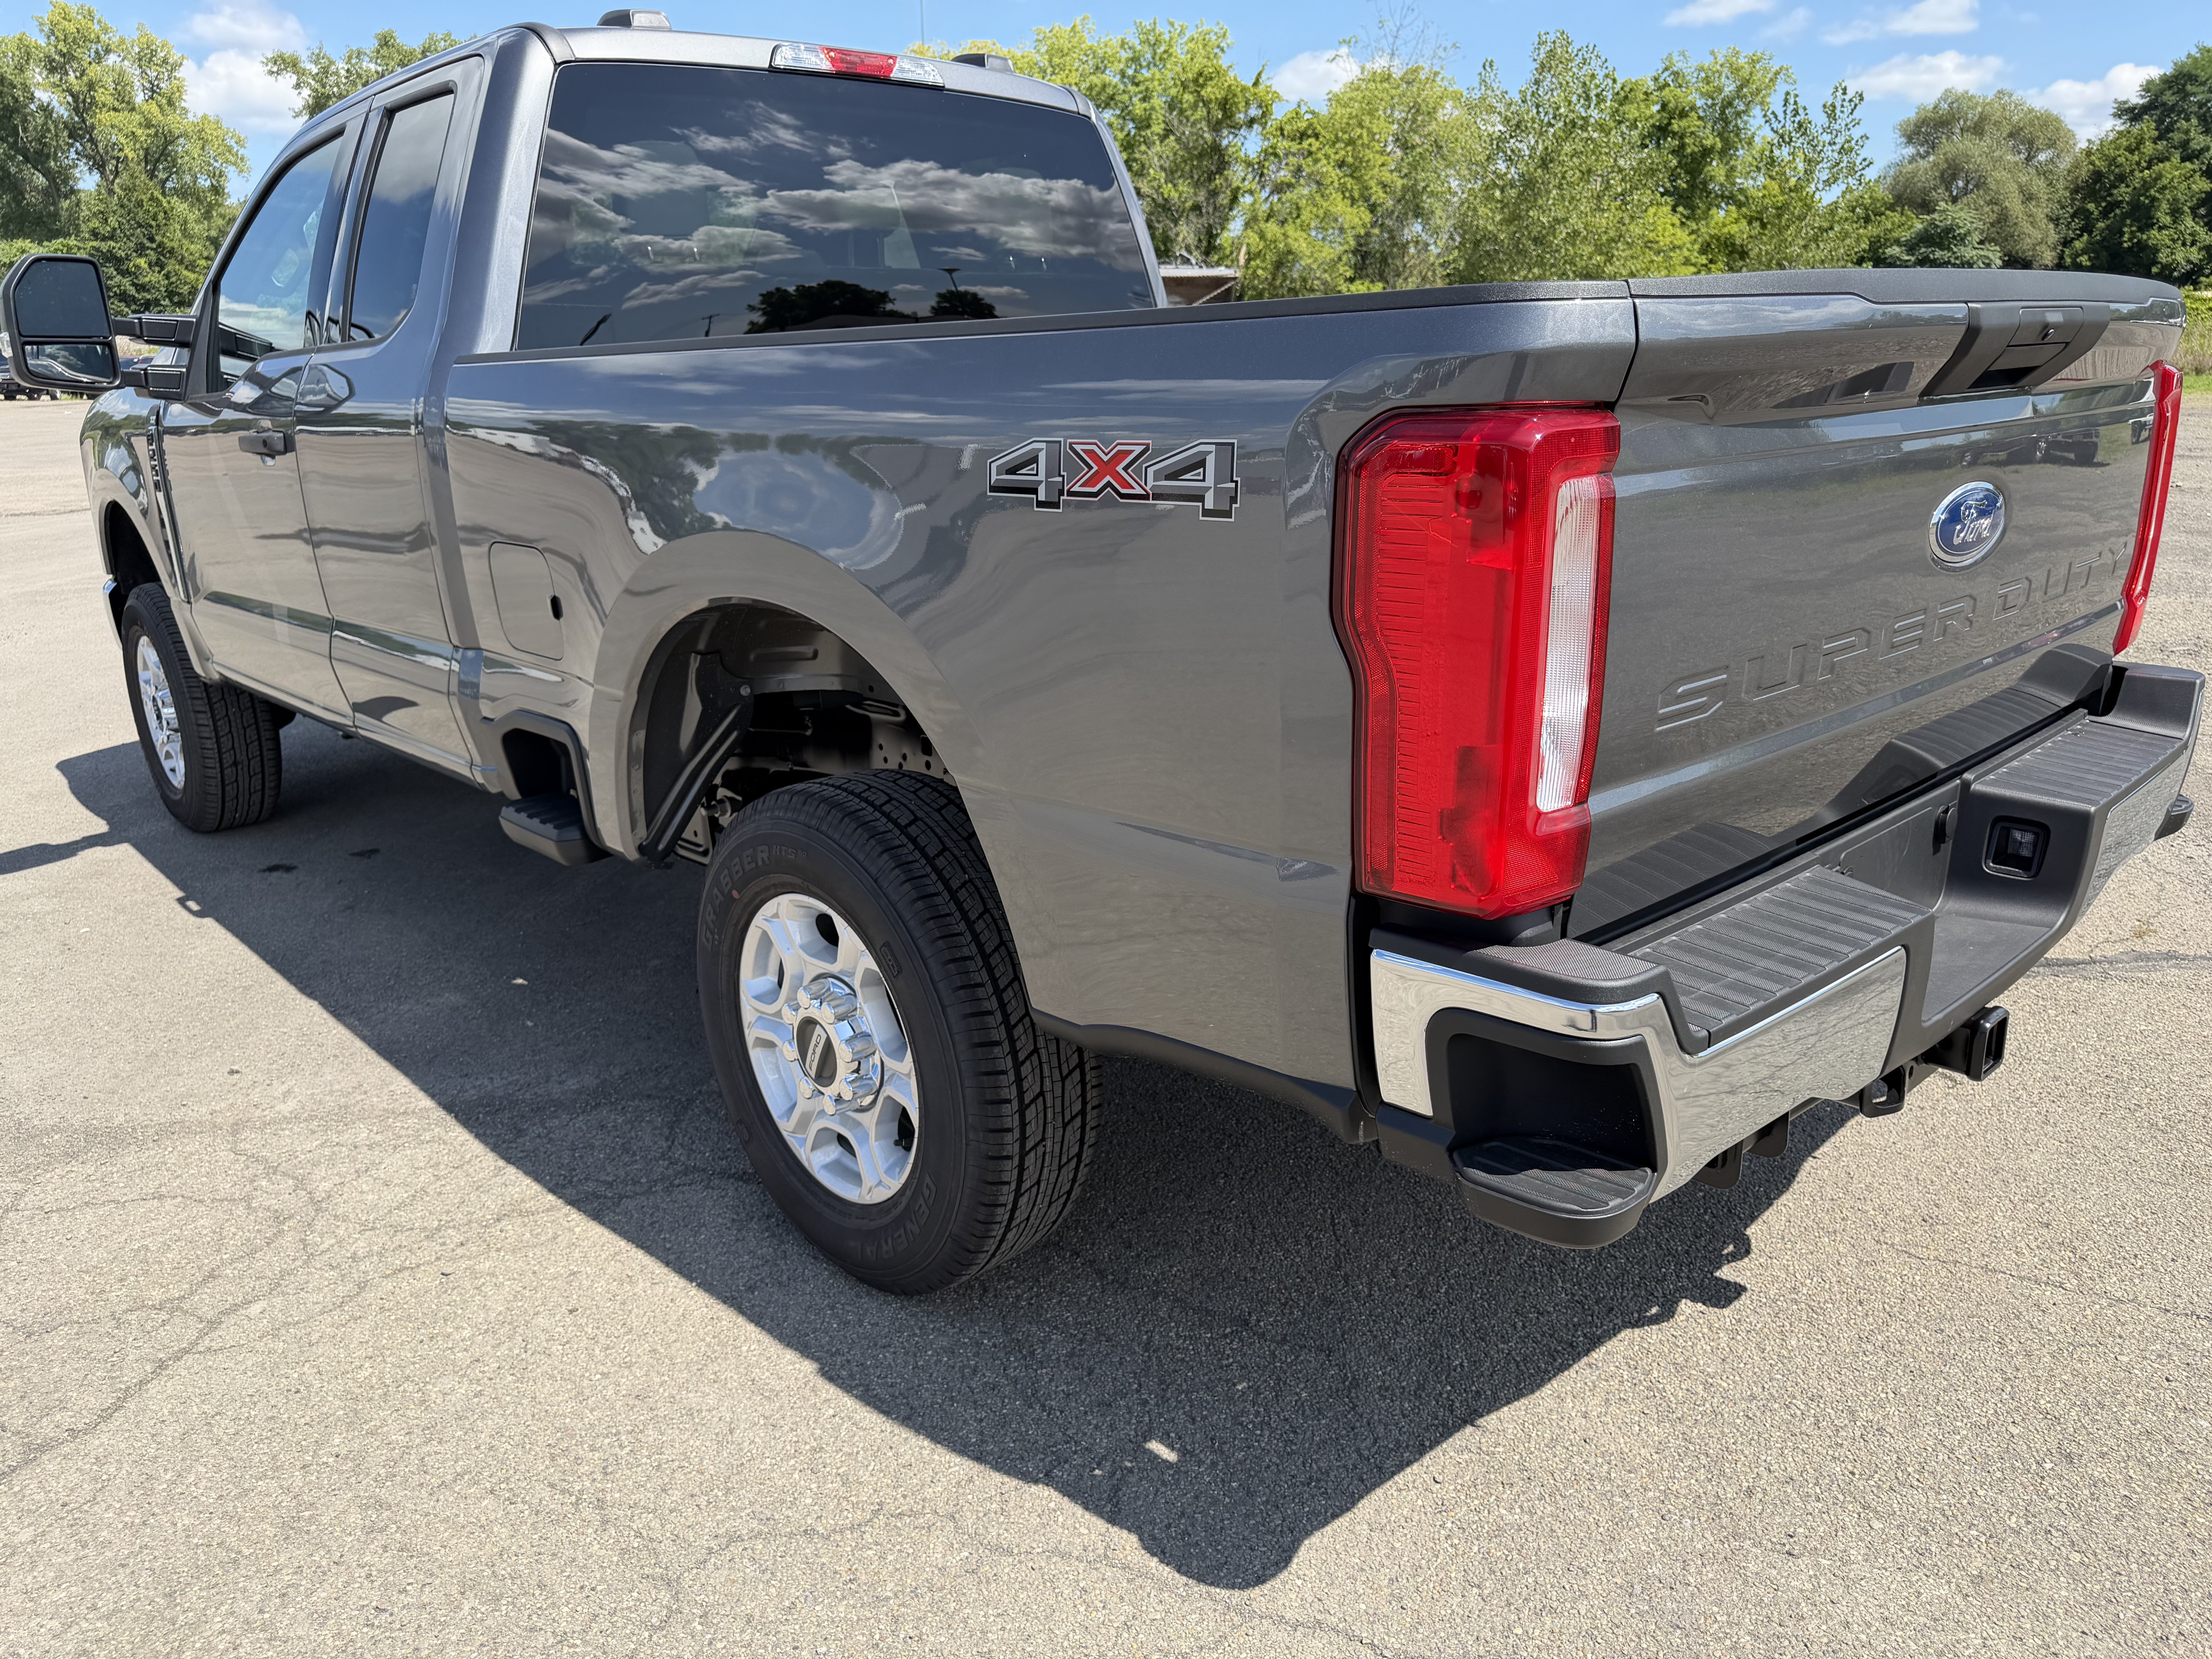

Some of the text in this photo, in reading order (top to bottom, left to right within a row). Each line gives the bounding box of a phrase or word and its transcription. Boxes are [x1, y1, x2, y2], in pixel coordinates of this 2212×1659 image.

[1953, 500, 1995, 544] Ford
[1656, 540, 2128, 732] SUPER DUTY
[703, 845, 771, 952] GRABBER
[809, 1034, 821, 1072] FORD
[848, 1171, 937, 1261] GENERAL
